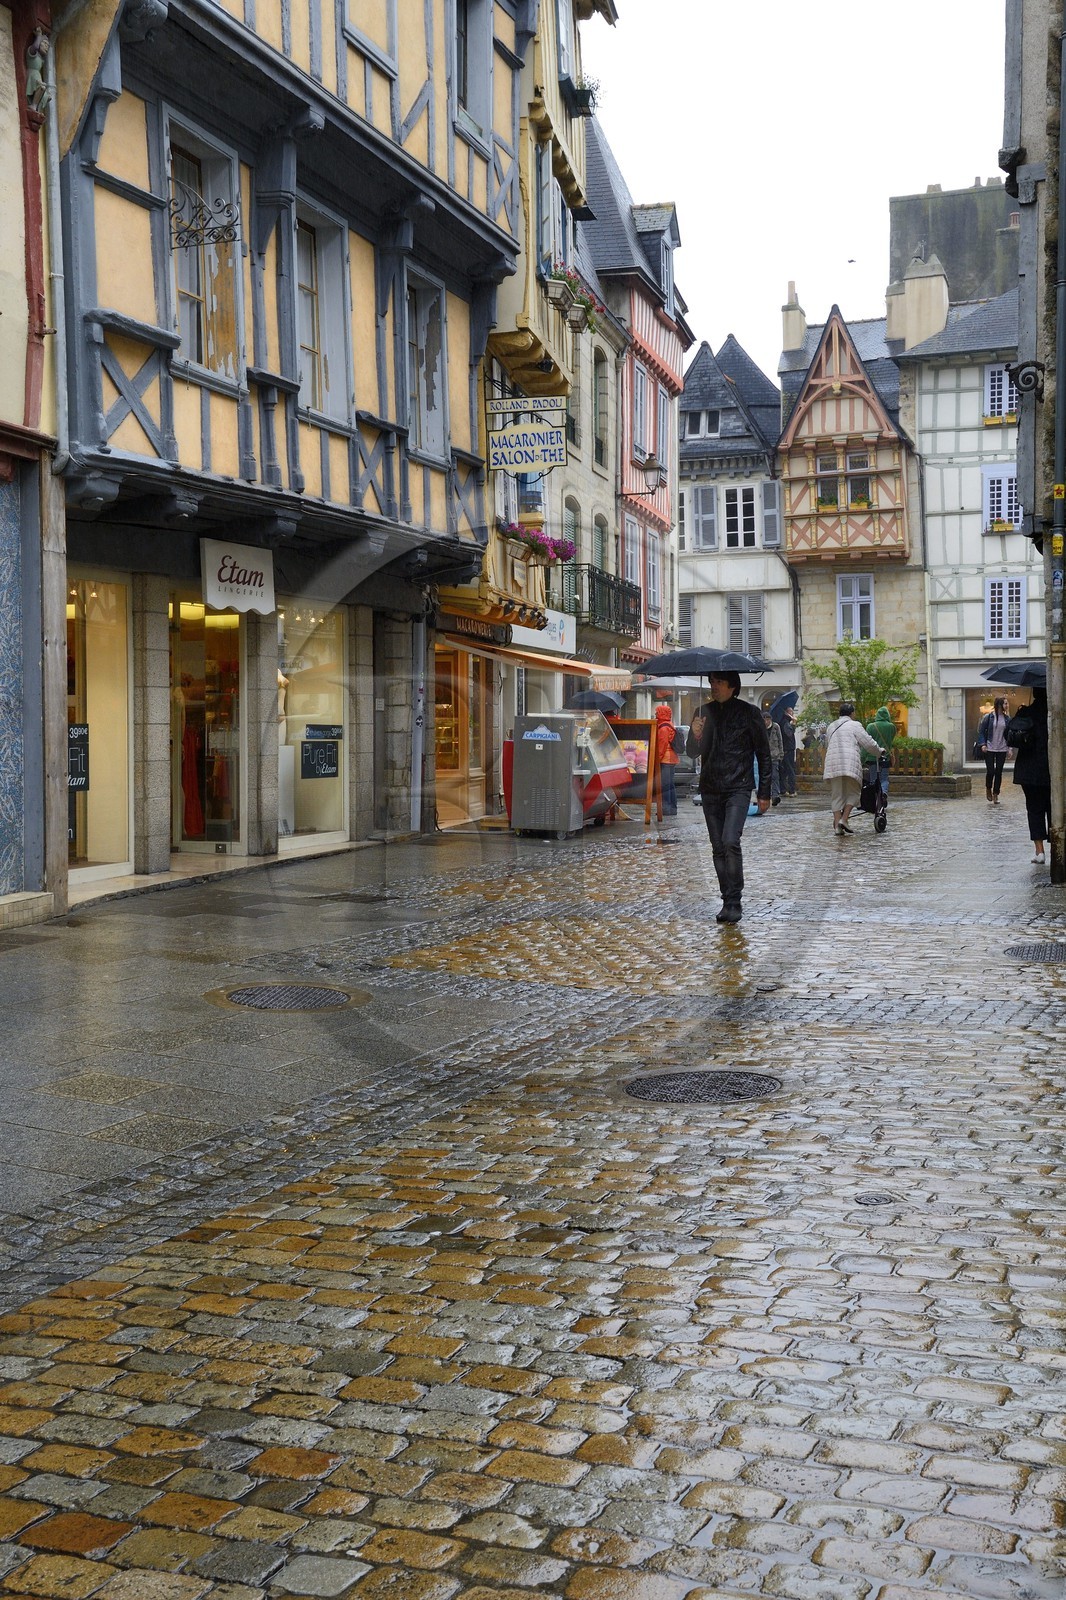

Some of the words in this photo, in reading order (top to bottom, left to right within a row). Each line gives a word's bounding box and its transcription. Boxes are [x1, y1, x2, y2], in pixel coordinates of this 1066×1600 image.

[490, 400, 529, 411] ROLLAND
[532, 398, 563, 409] PADOU
[491, 430, 563, 449] MACARONIER
[492, 449, 535, 466] SALON
[541, 448, 564, 463] THE
[217, 554, 264, 588] Etam
[218, 585, 264, 598] LINGERIE
[303, 743, 325, 764] Pure
[326, 743, 337, 764] Fit
[321, 762, 336, 774] Etam
[68, 774, 86, 786] tam
